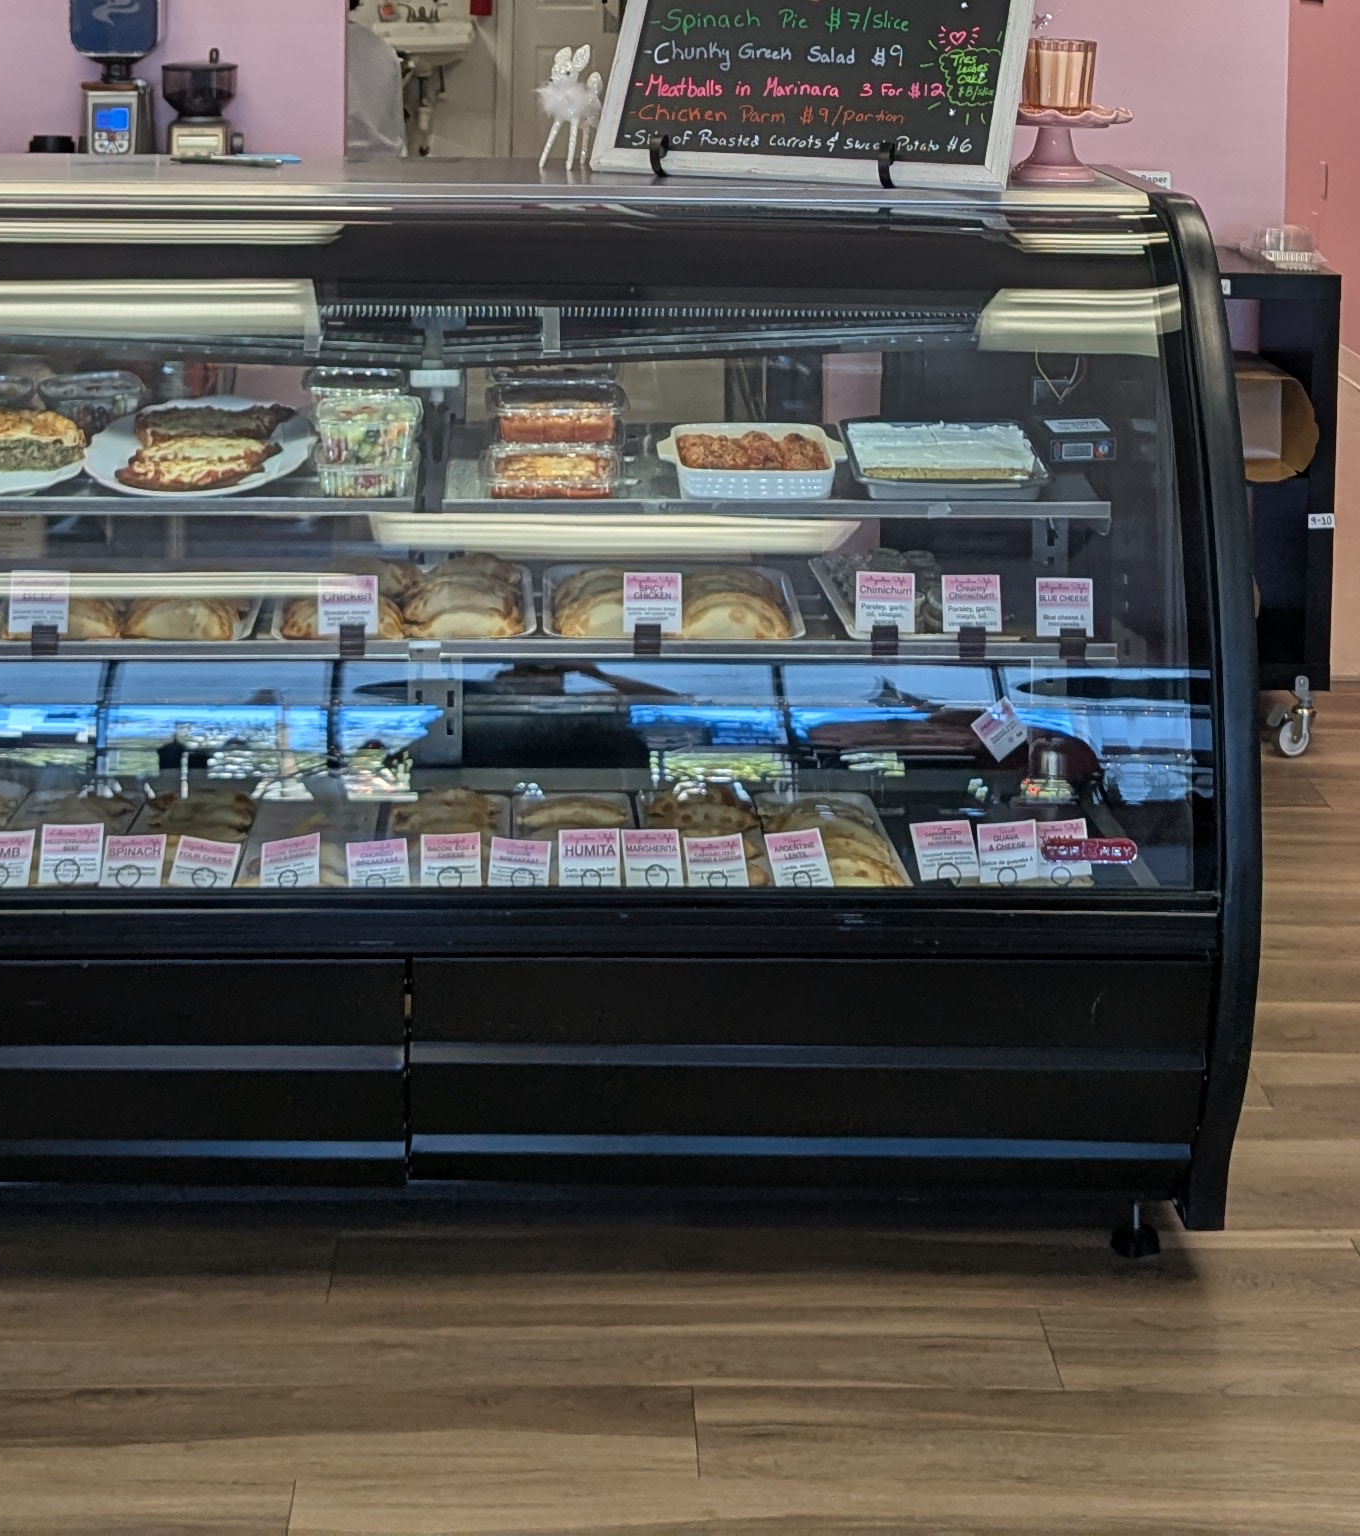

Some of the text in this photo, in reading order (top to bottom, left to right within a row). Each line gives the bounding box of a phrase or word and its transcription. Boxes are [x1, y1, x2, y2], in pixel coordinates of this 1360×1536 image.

[778, 8, 809, 30] Pie
[738, 42, 792, 61] Greek
[807, 45, 856, 64] Salad
[871, 43, 904, 67] $9
[950, 52, 978, 65] Tres
[735, 80, 751, 97] in
[762, 75, 840, 98] Marinara
[859, 82, 873, 98] 3
[907, 81, 946, 99] $12
[739, 104, 786, 124] Parm
[698, 129, 760, 148] Roasted
[896, 135, 940, 152] Potato
[946, 135, 973, 153] $6
[859, 584, 913, 595] Chimichurri
[955, 584, 987, 594] Creamy
[323, 591, 372, 602] Chicken
[633, 591, 672, 600] CHICKEN
[949, 591, 995, 600] Chimichurri
[1039, 594, 1089, 604] BLUE CHEESE
[109, 846, 161, 857] SPINACH
[564, 843, 616, 857] HUMITA
[625, 844, 678, 853] MARGHERITA
[773, 843, 816, 854] ARGENTINE
